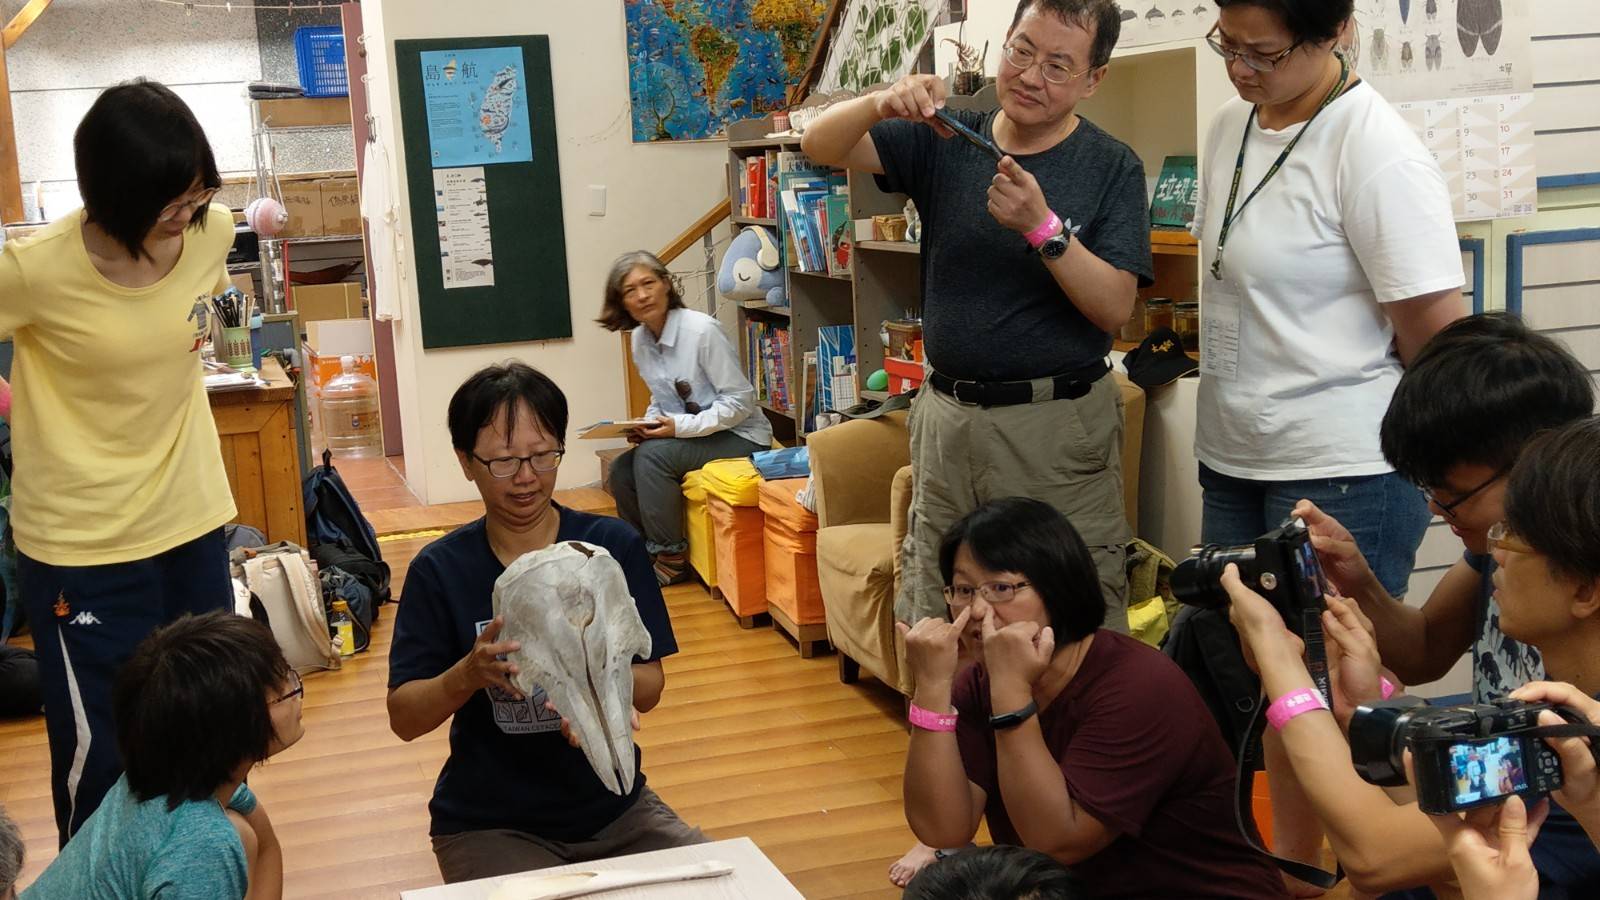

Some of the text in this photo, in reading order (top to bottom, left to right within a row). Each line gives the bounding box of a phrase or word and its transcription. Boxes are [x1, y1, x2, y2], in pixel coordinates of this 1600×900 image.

[425, 61, 478, 80] 島 航
[1463, 106, 1469, 114] 2
[1498, 104, 1505, 112] 3
[1464, 128, 1470, 137] 9
[1500, 125, 1510, 133] 10
[1465, 149, 1474, 157] 16
[1501, 147, 1510, 155] 17
[1466, 168, 1512, 180] 23 24
[1467, 191, 1513, 202] 30 31
